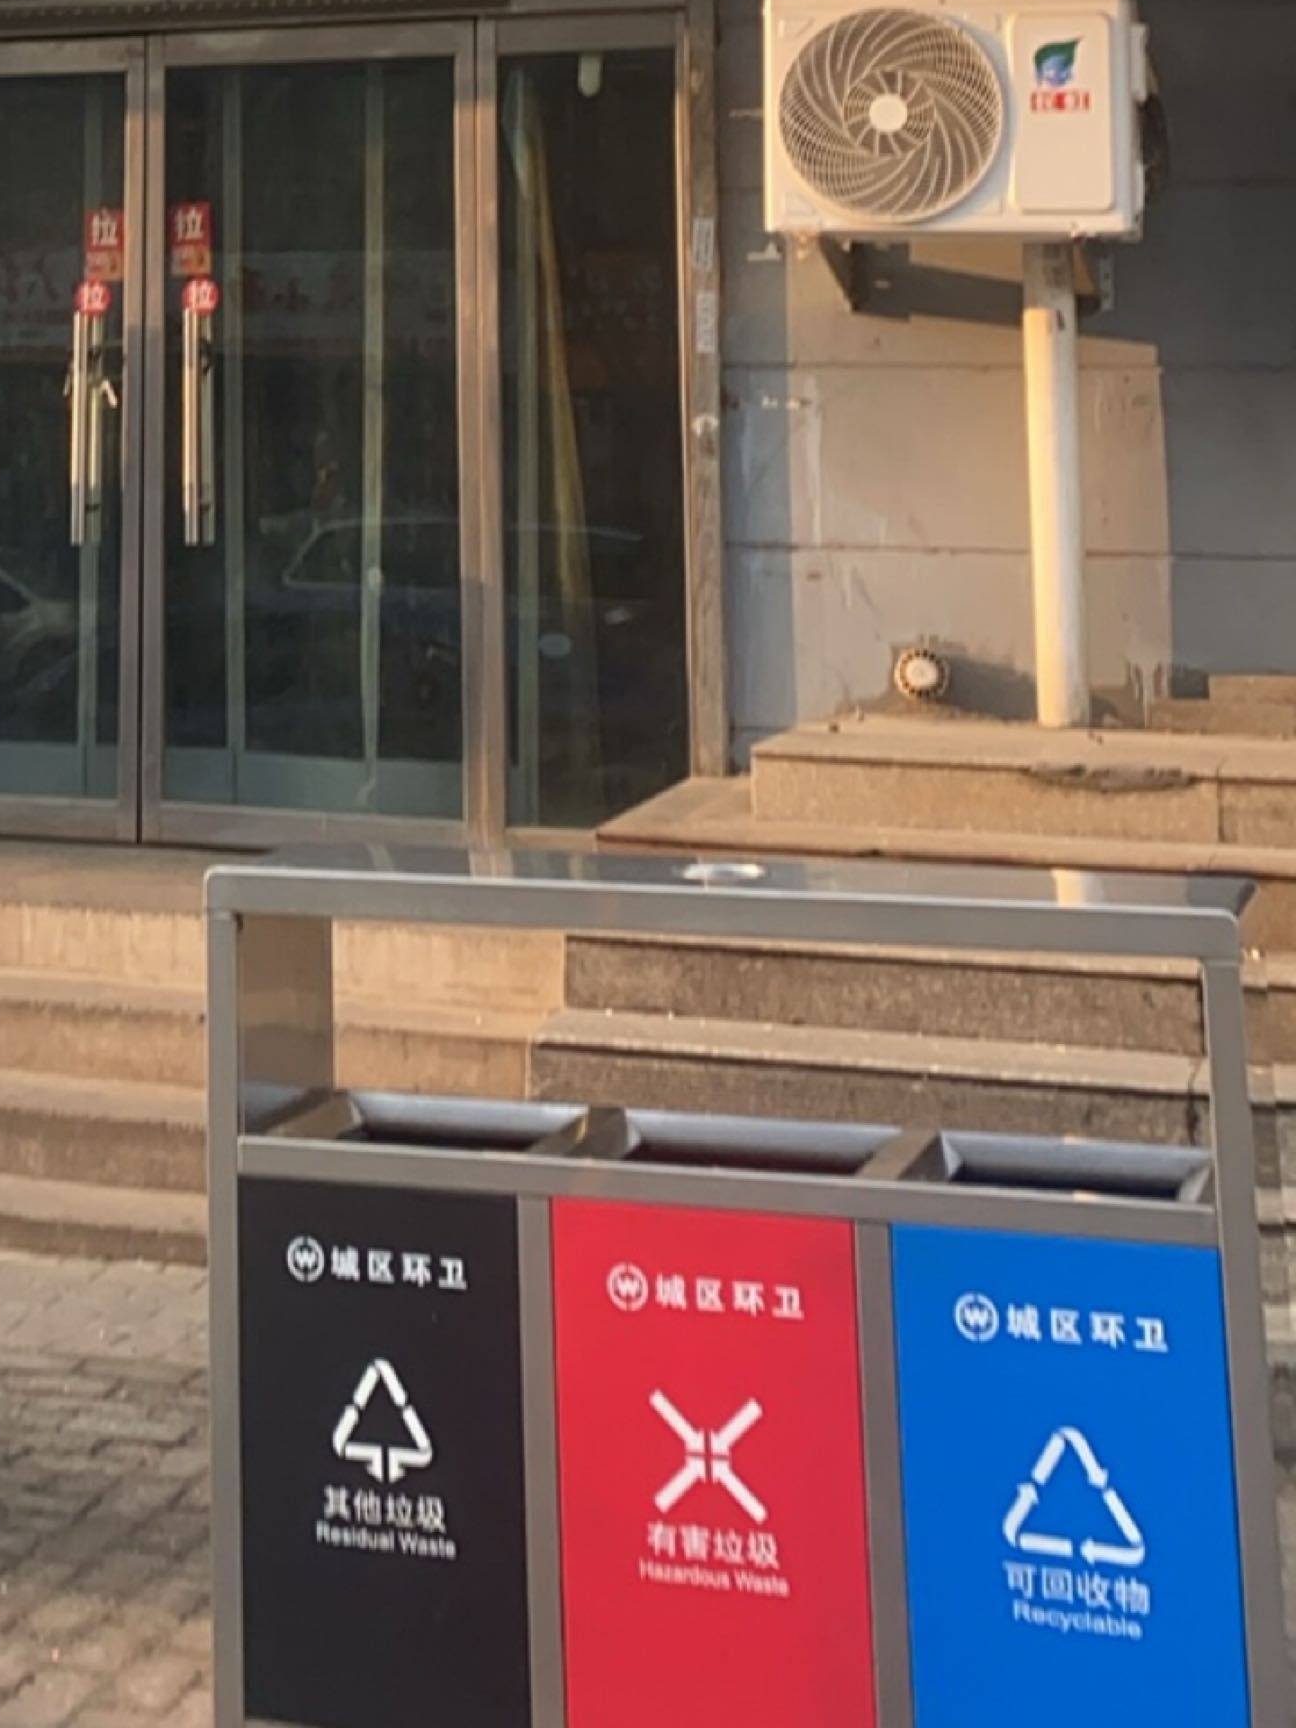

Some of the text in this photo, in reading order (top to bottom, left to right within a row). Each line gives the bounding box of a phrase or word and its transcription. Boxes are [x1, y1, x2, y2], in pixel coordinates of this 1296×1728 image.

[92, 208, 118, 246] 拉
[176, 206, 203, 241] 拉
[330, 1245, 468, 1291] 城区环卫
[655, 1272, 805, 1321] 城区环卫
[1007, 1302, 1169, 1354] 城区环卫
[323, 1484, 447, 1534] 其他垃圾
[316, 1520, 457, 1561] Residual Waste
[647, 1520, 780, 1571] 有害垃圾
[733, 1568, 790, 1598] Waste
[1003, 1560, 1150, 1616] 可回收物
[1013, 1599, 1145, 1641] Recyclable
